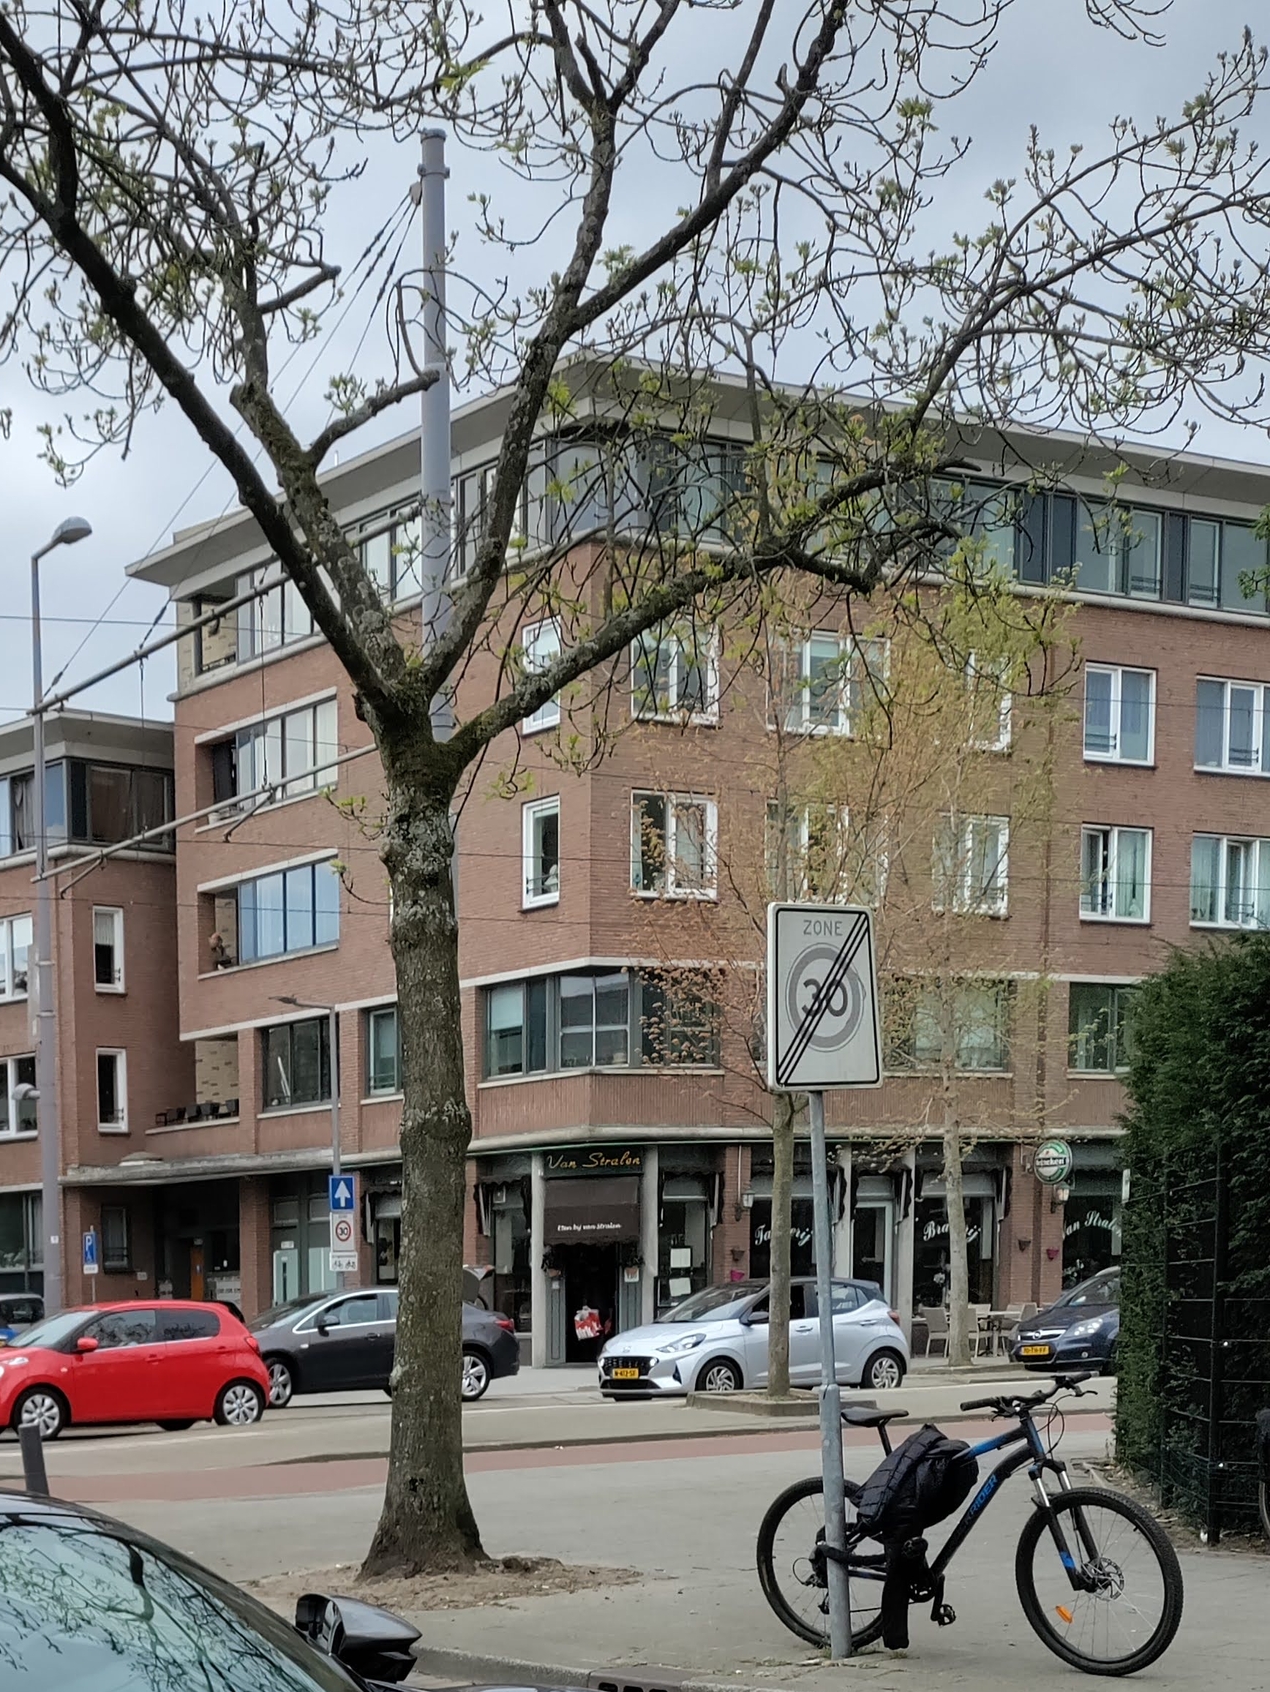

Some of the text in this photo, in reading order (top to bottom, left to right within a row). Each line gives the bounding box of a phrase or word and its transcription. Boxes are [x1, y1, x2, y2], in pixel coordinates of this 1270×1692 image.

[803, 919, 843, 936] ZONE
[801, 978, 848, 1017] 30
[546, 1154, 577, 1169] Van
[339, 1227, 348, 1236] 30
